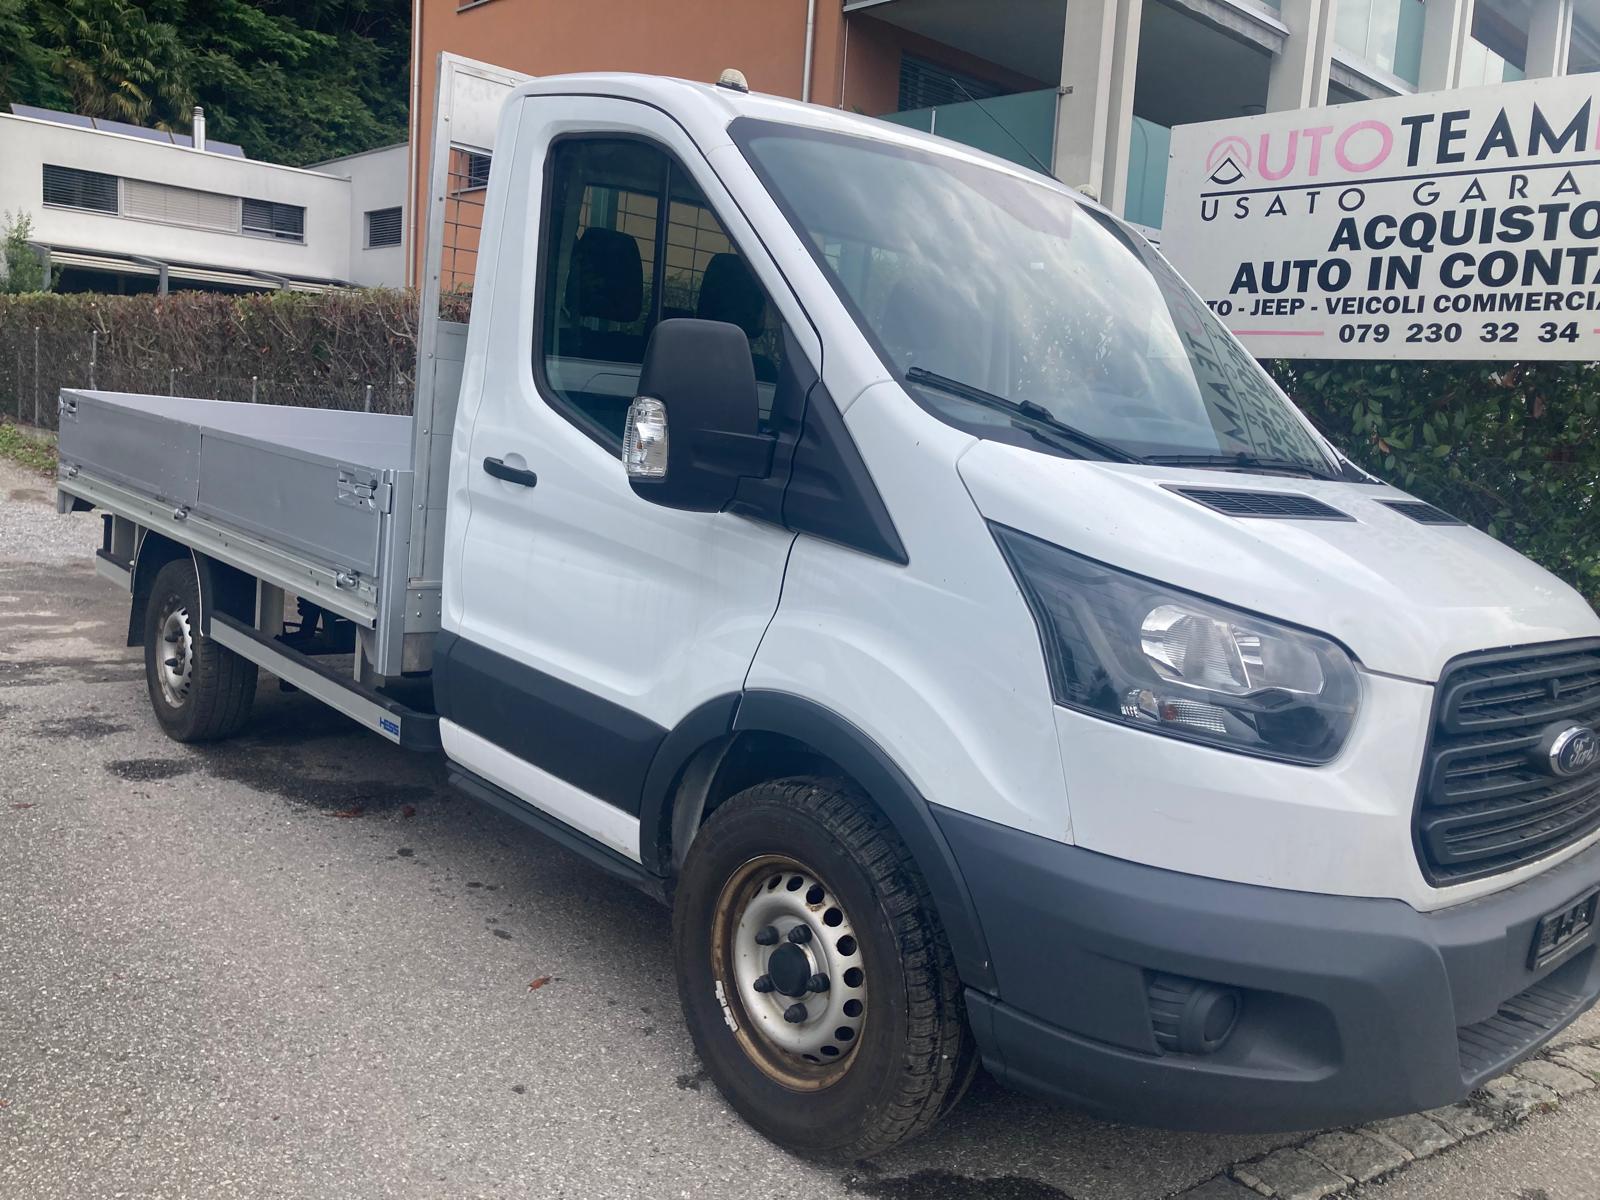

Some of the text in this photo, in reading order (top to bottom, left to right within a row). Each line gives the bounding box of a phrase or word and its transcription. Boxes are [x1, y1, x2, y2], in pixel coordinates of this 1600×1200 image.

[1201, 188, 1365, 221] USATO
[1328, 201, 1600, 252] ACQUISTO
[1229, 247, 1600, 295] AUTO IN CONT
[1250, 298, 1305, 316] JEEP
[1325, 295, 1425, 315] VEICOLI
[1433, 291, 1600, 313] COMMERCI
[1339, 322, 1580, 343] 079 230 32 34
[1569, 737, 1595, 768] Ford
